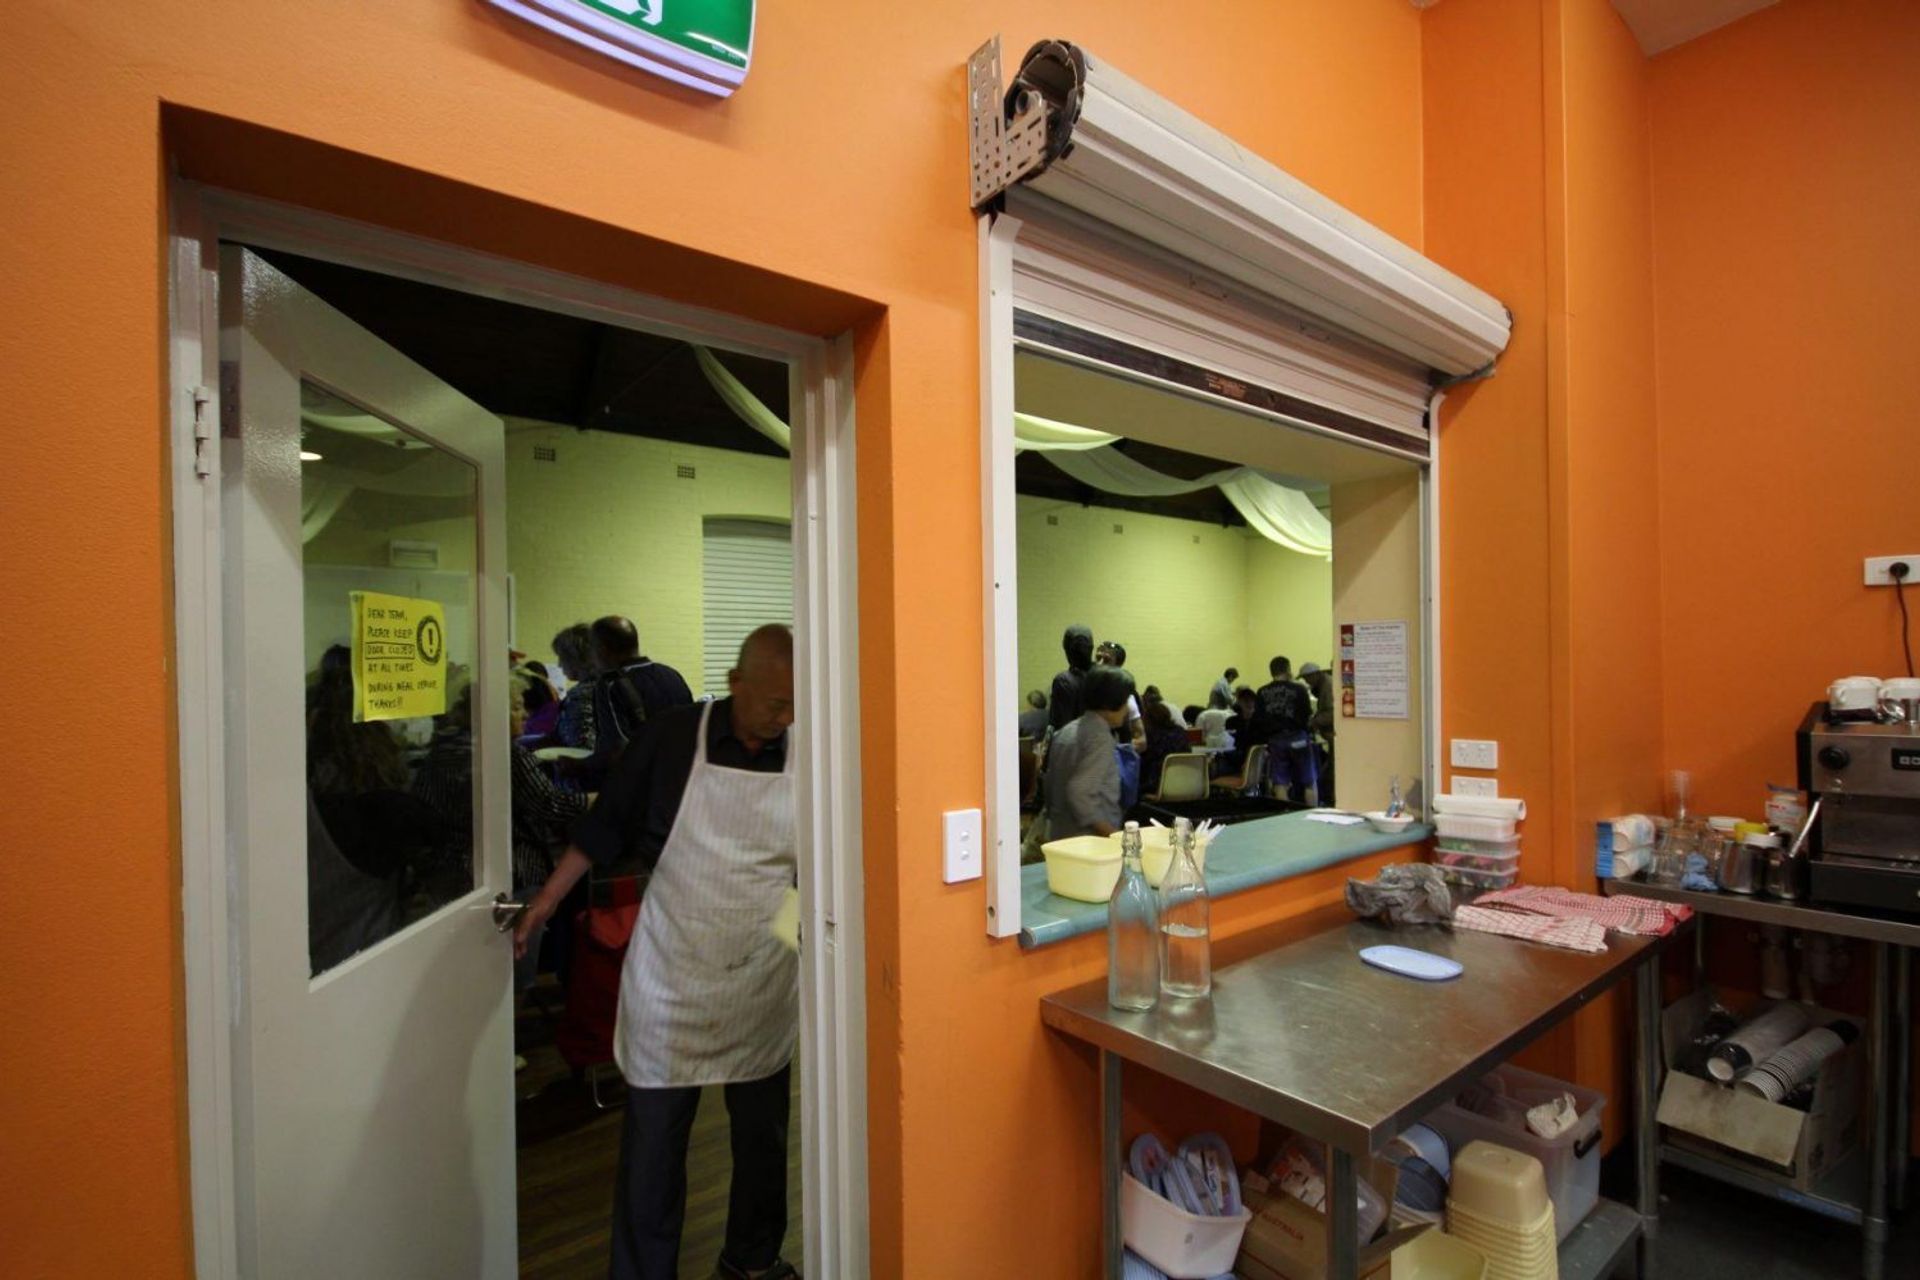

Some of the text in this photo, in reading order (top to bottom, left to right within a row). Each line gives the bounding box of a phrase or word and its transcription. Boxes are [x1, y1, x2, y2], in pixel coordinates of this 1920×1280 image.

[367, 625, 413, 639] PLEASE KEEP
[388, 645, 413, 656] CLOSED
[368, 663, 414, 673] AT ALL TIMES
[368, 681, 394, 694] DURING
[396, 681, 415, 692] MEAL
